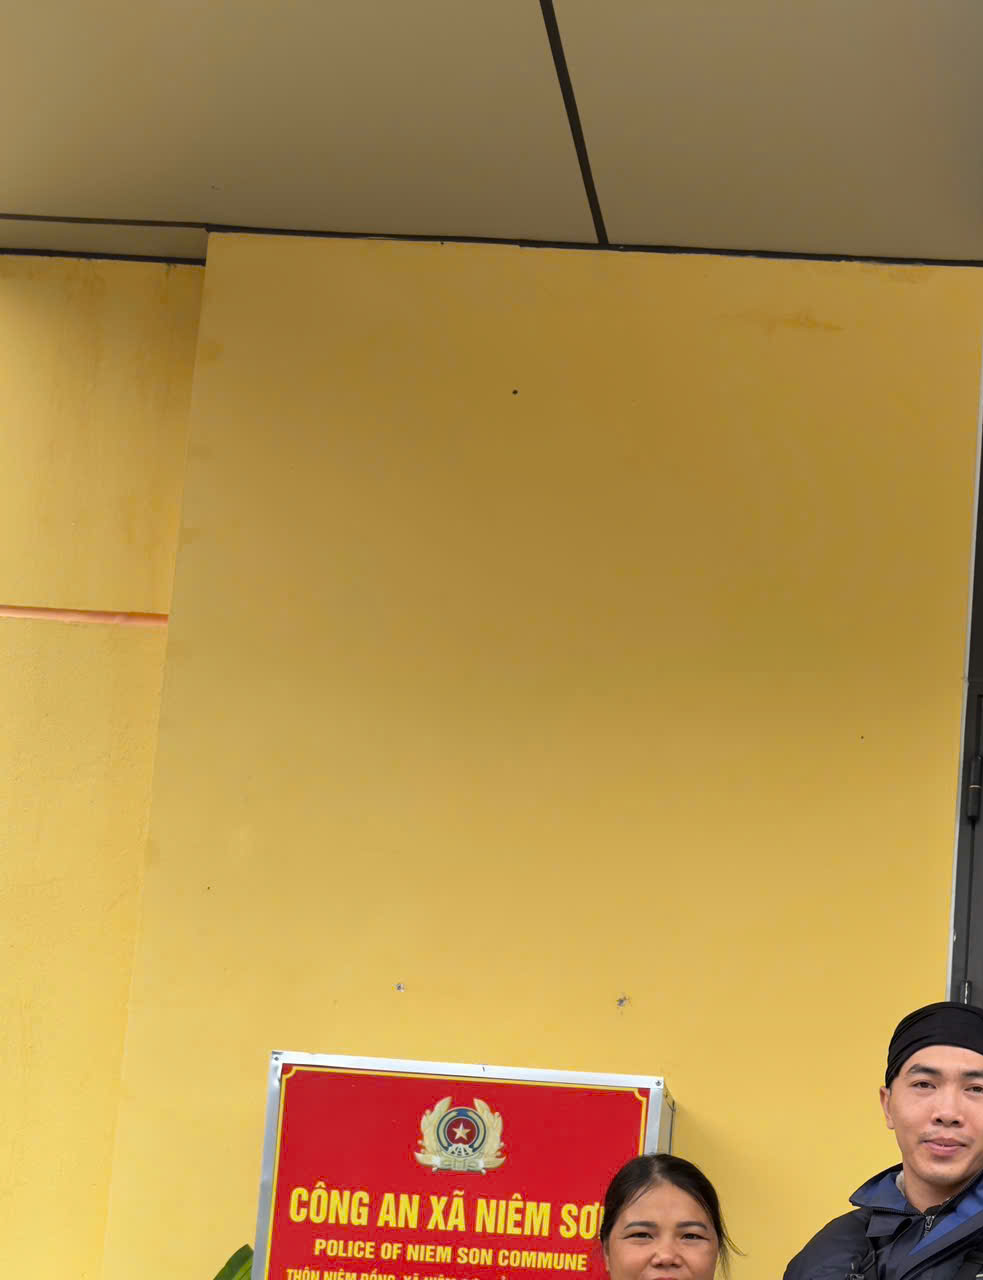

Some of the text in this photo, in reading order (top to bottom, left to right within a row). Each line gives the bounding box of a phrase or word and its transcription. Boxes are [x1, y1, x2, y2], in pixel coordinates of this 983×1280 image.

[289, 1181, 605, 1240] CÔNG AN XÃ NIÊM SƠ
[314, 1239, 588, 1271] POLICE OF NIEM SON COMMUNE
